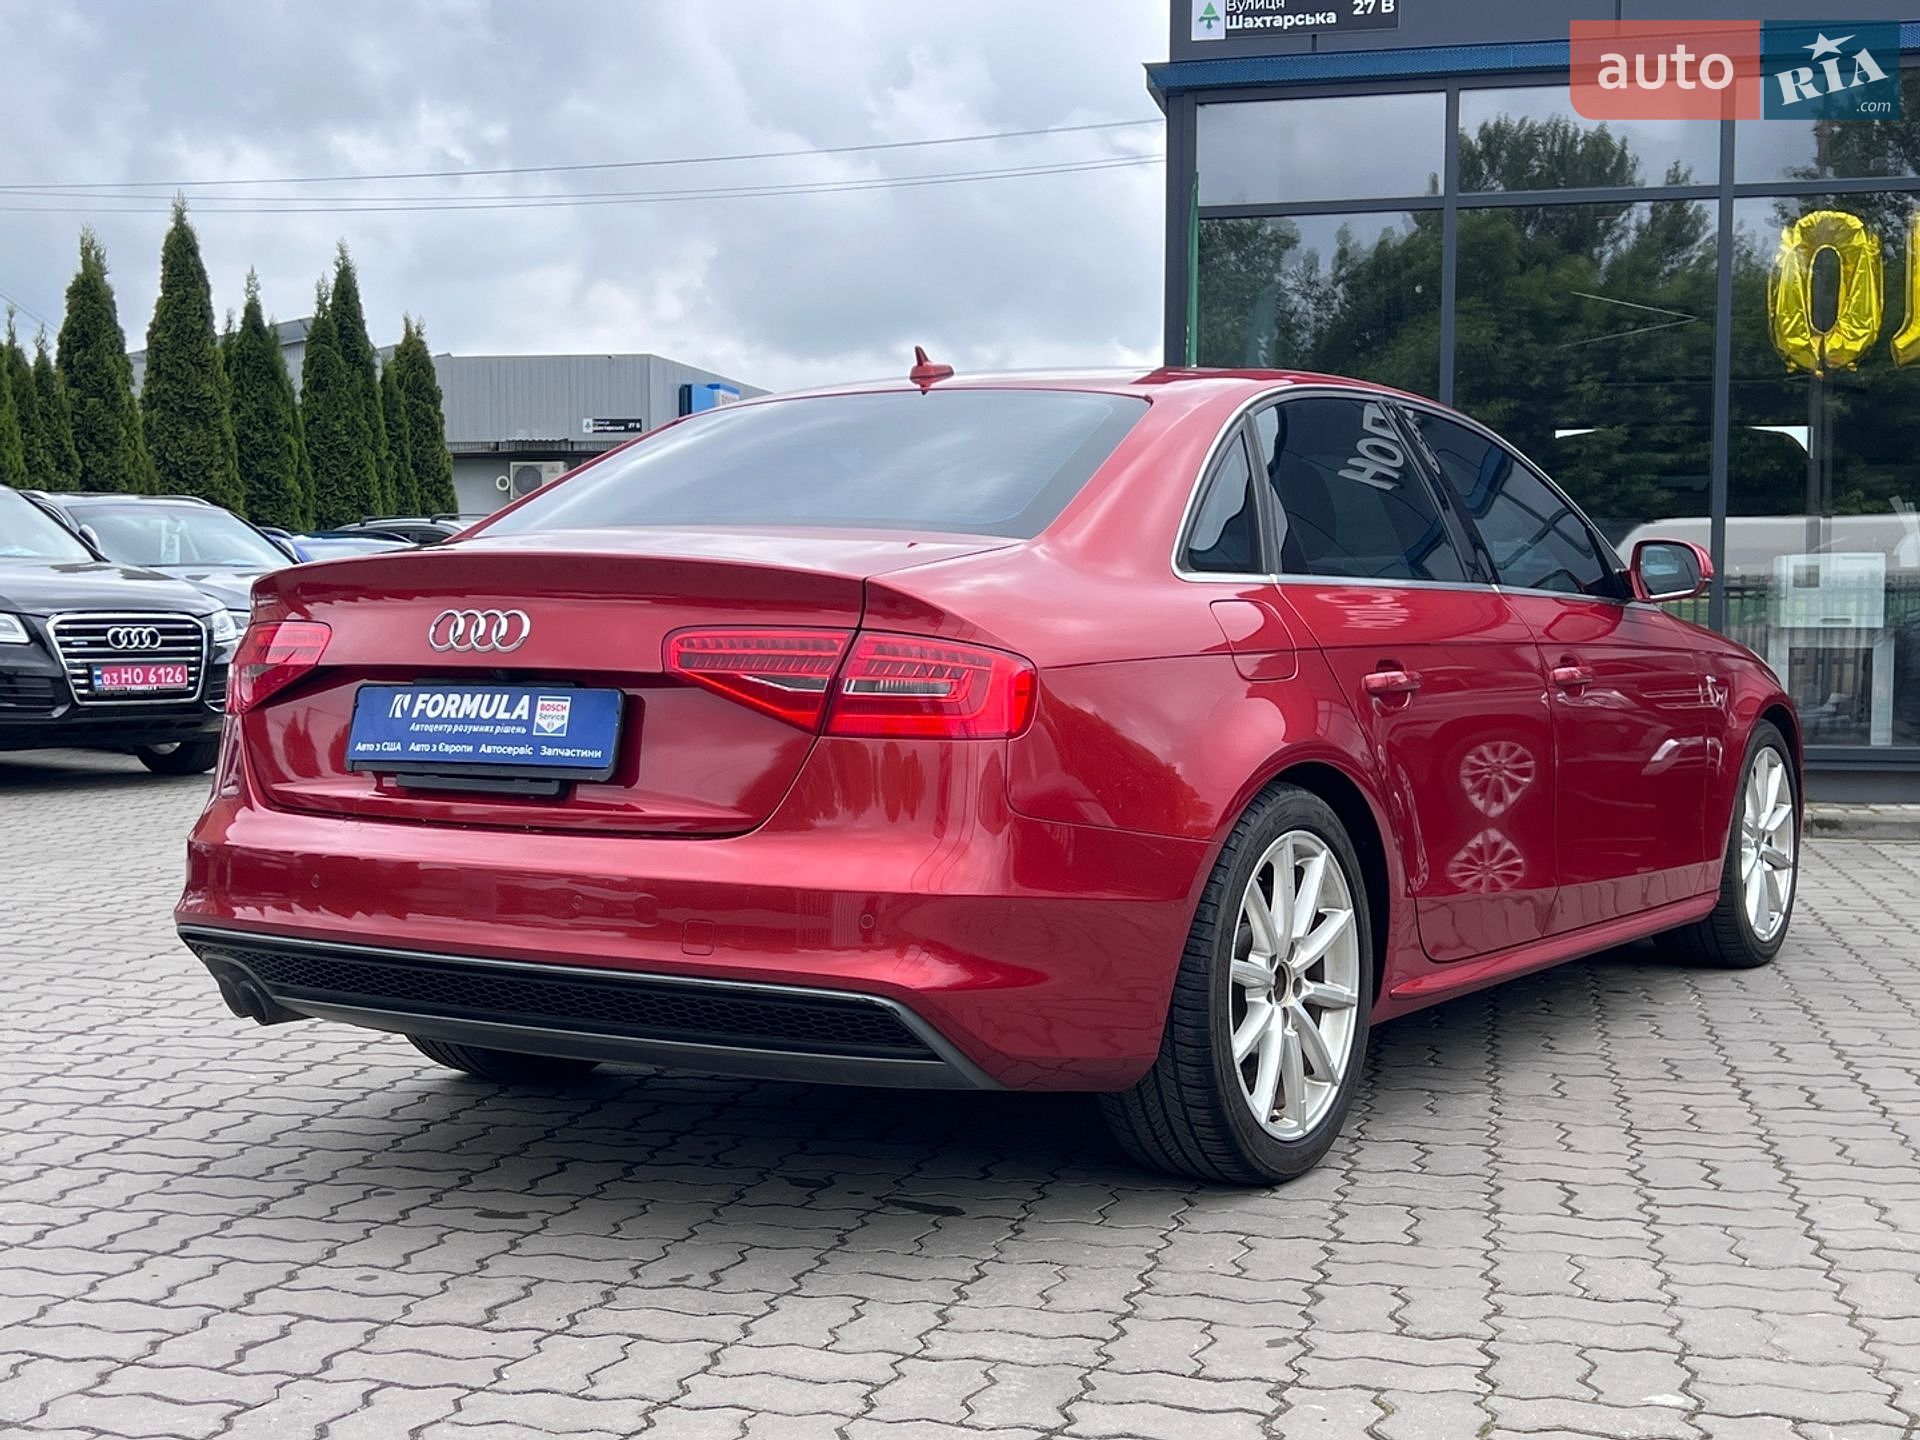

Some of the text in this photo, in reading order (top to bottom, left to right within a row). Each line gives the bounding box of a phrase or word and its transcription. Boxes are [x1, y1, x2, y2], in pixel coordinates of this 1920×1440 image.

[1226, 0, 1285, 13] Вулиця
[1352, 0, 1375, 15] 27
[1226, 11, 1337, 30] Шахтарська
[103, 673, 118, 685] 03
[121, 668, 143, 684] HO
[149, 667, 183, 683] 6126
[412, 693, 530, 720] FORMULA
[540, 703, 567, 712] BOSCH
[538, 712, 566, 721] Service
[410, 722, 453, 734] Автоцентр
[495, 723, 527, 735] рішень
[355, 741, 375, 752] Авто
[381, 741, 402, 752] США
[409, 742, 430, 752] Авто
[438, 743, 473, 755] Європи
[479, 743, 534, 757] Автосервіс
[540, 746, 602, 759] Запчастини
